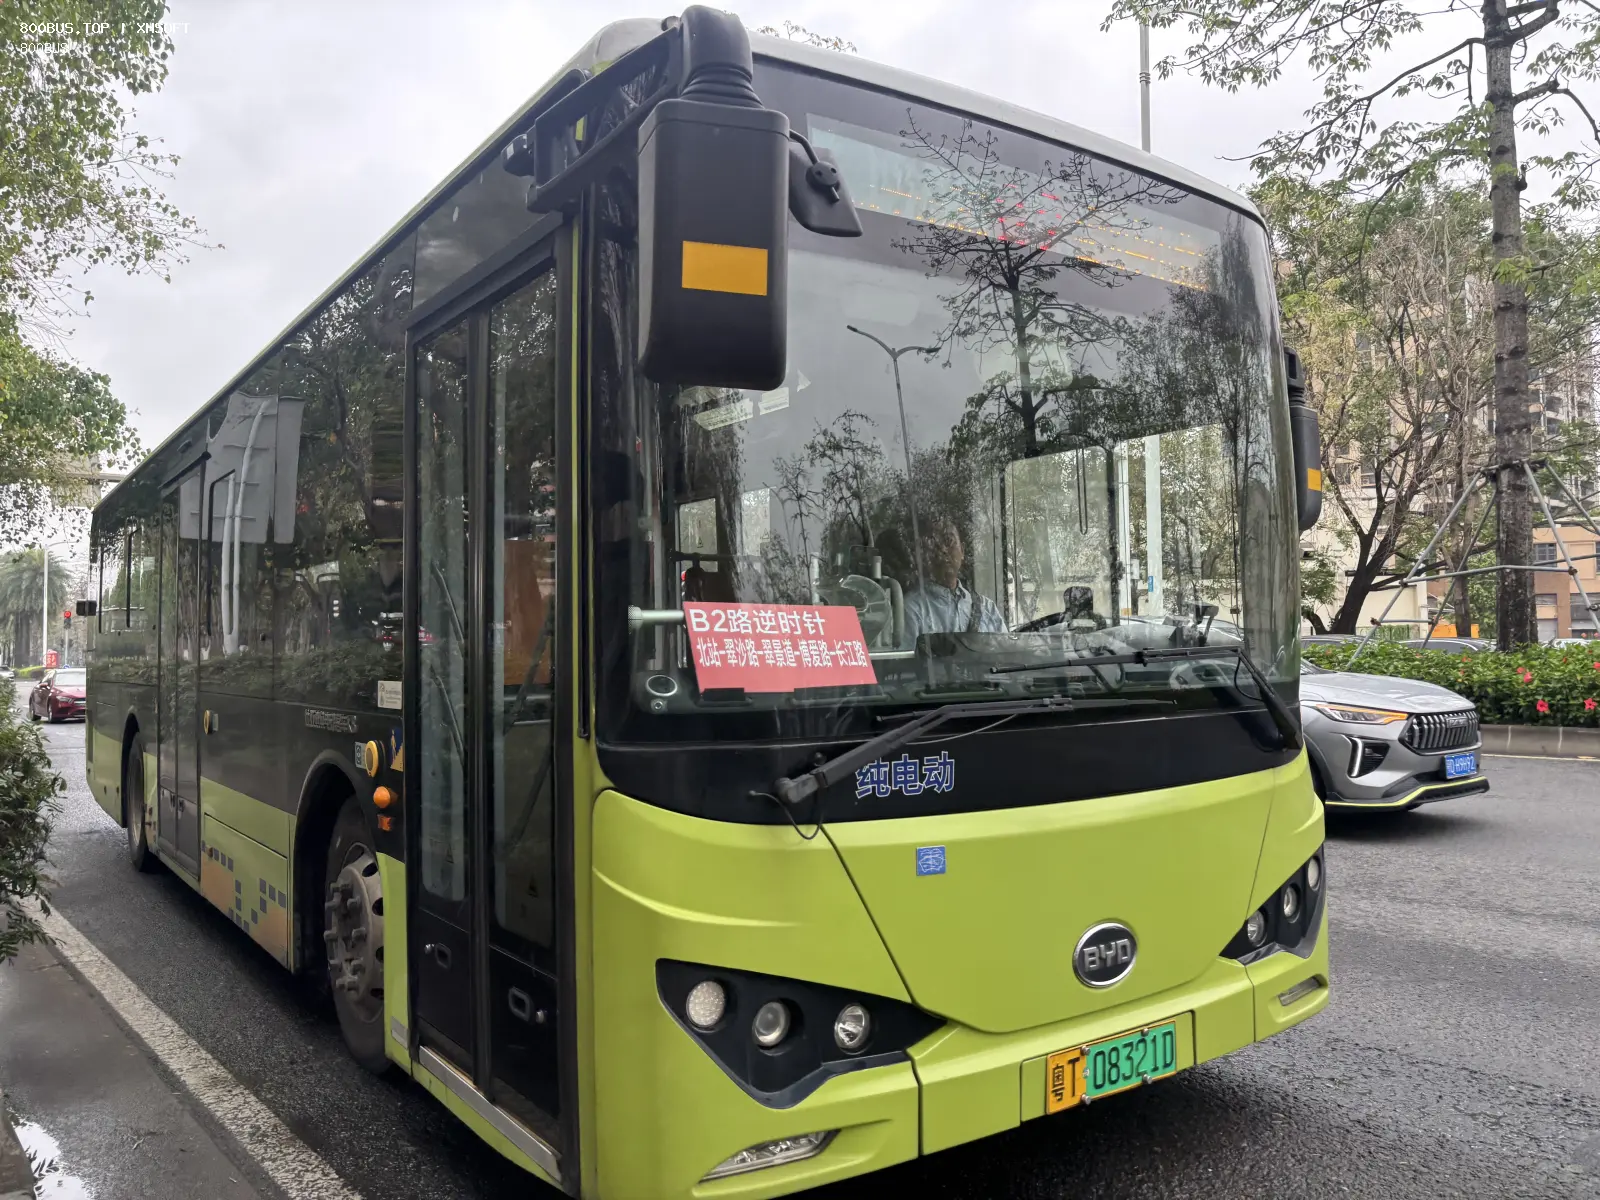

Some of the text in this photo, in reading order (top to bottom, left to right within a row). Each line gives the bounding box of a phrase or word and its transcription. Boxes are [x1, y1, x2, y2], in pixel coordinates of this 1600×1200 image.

[689, 608, 826, 636] B2路逆时针
[855, 751, 955, 799] 纯电动
[1083, 938, 1132, 972] BYD
